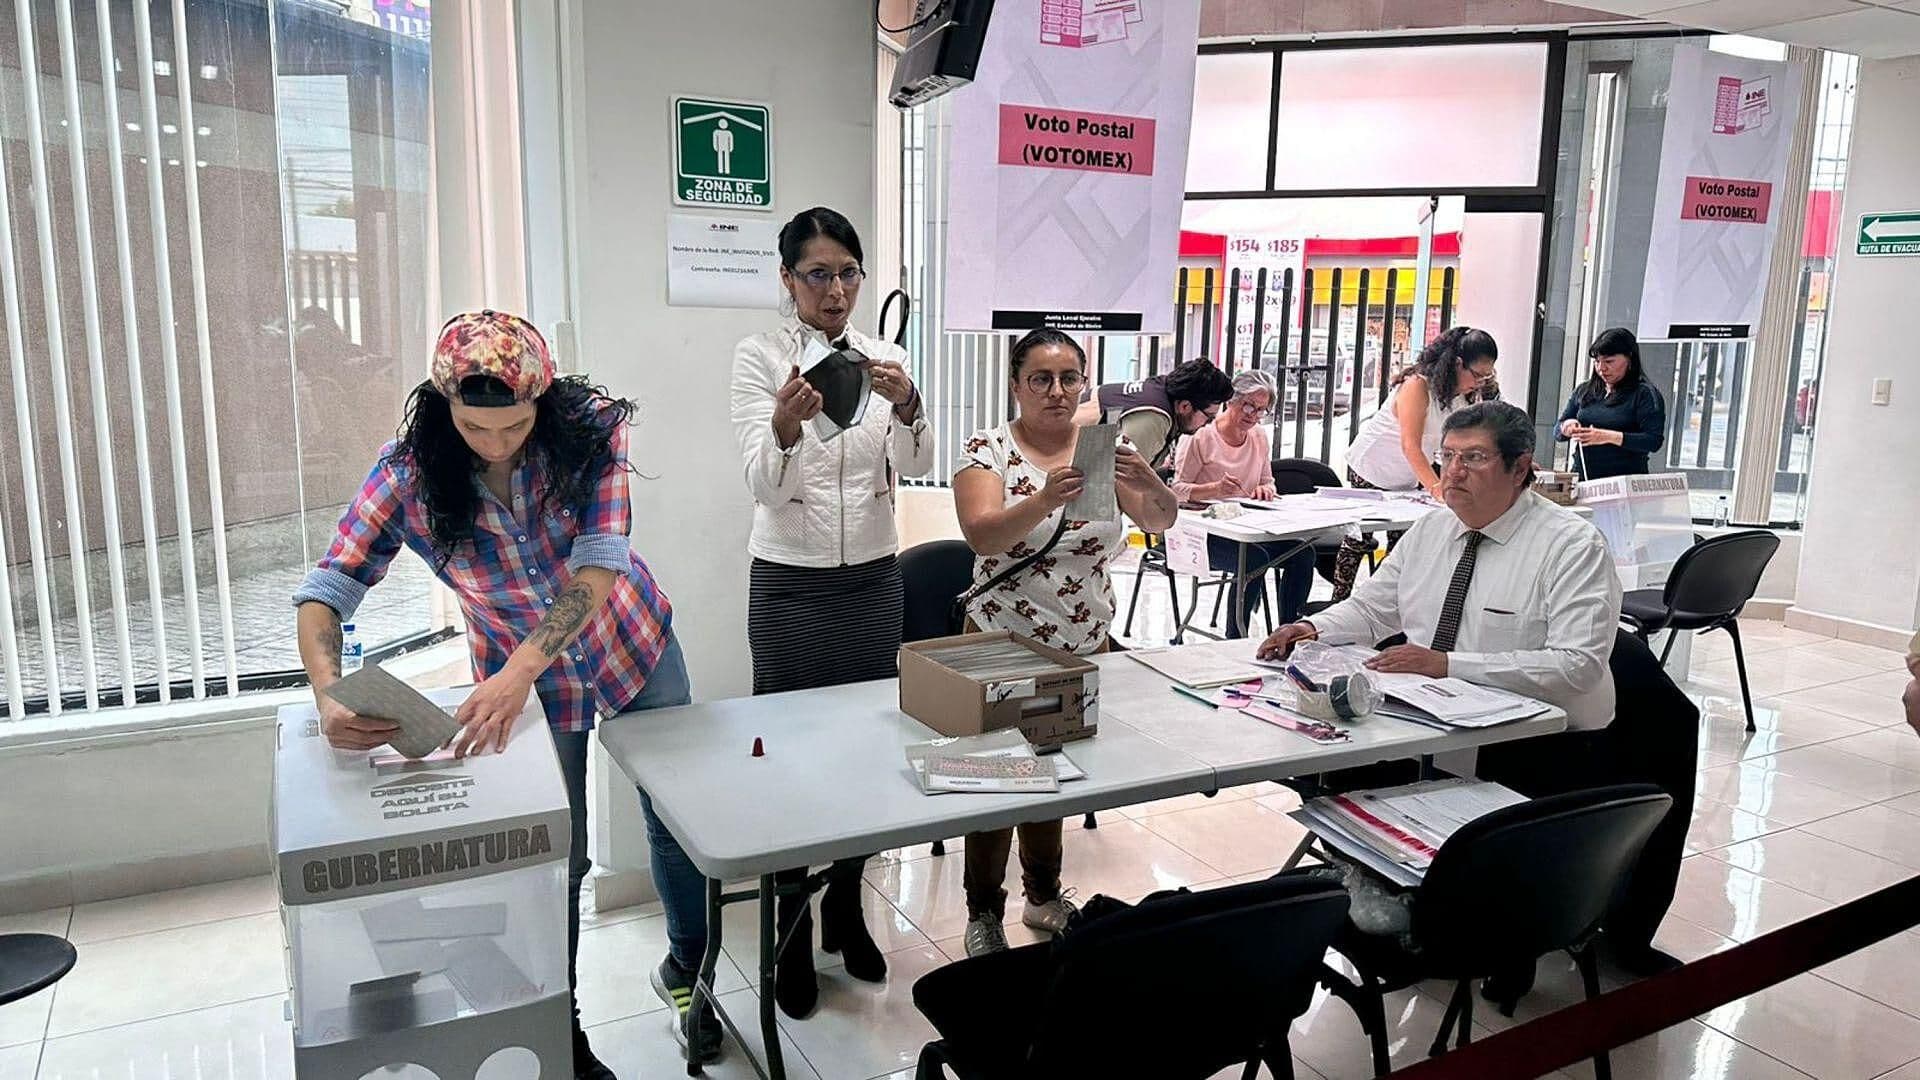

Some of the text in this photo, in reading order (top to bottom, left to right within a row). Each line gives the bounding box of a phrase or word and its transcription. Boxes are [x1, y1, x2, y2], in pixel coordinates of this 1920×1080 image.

[1024, 113, 1134, 139] Voto Postal
[1023, 144, 1132, 172] (VOTOMEX)
[695, 179, 753, 193] ZONA DE
[1699, 182, 1760, 198] Voto Postal
[686, 189, 763, 204] SEGURIDAD
[1696, 204, 1757, 222] (VOTOMEX)
[1230, 239, 1299, 253] $154 $185
[1859, 245, 1879, 253] RUTA
[1880, 244, 1891, 253] DE
[1631, 477, 1685, 492] GUBERNATURA
[438, 791, 468, 801] SU
[384, 802, 470, 820] BOLETA
[302, 824, 552, 894] GUBERNATURA
